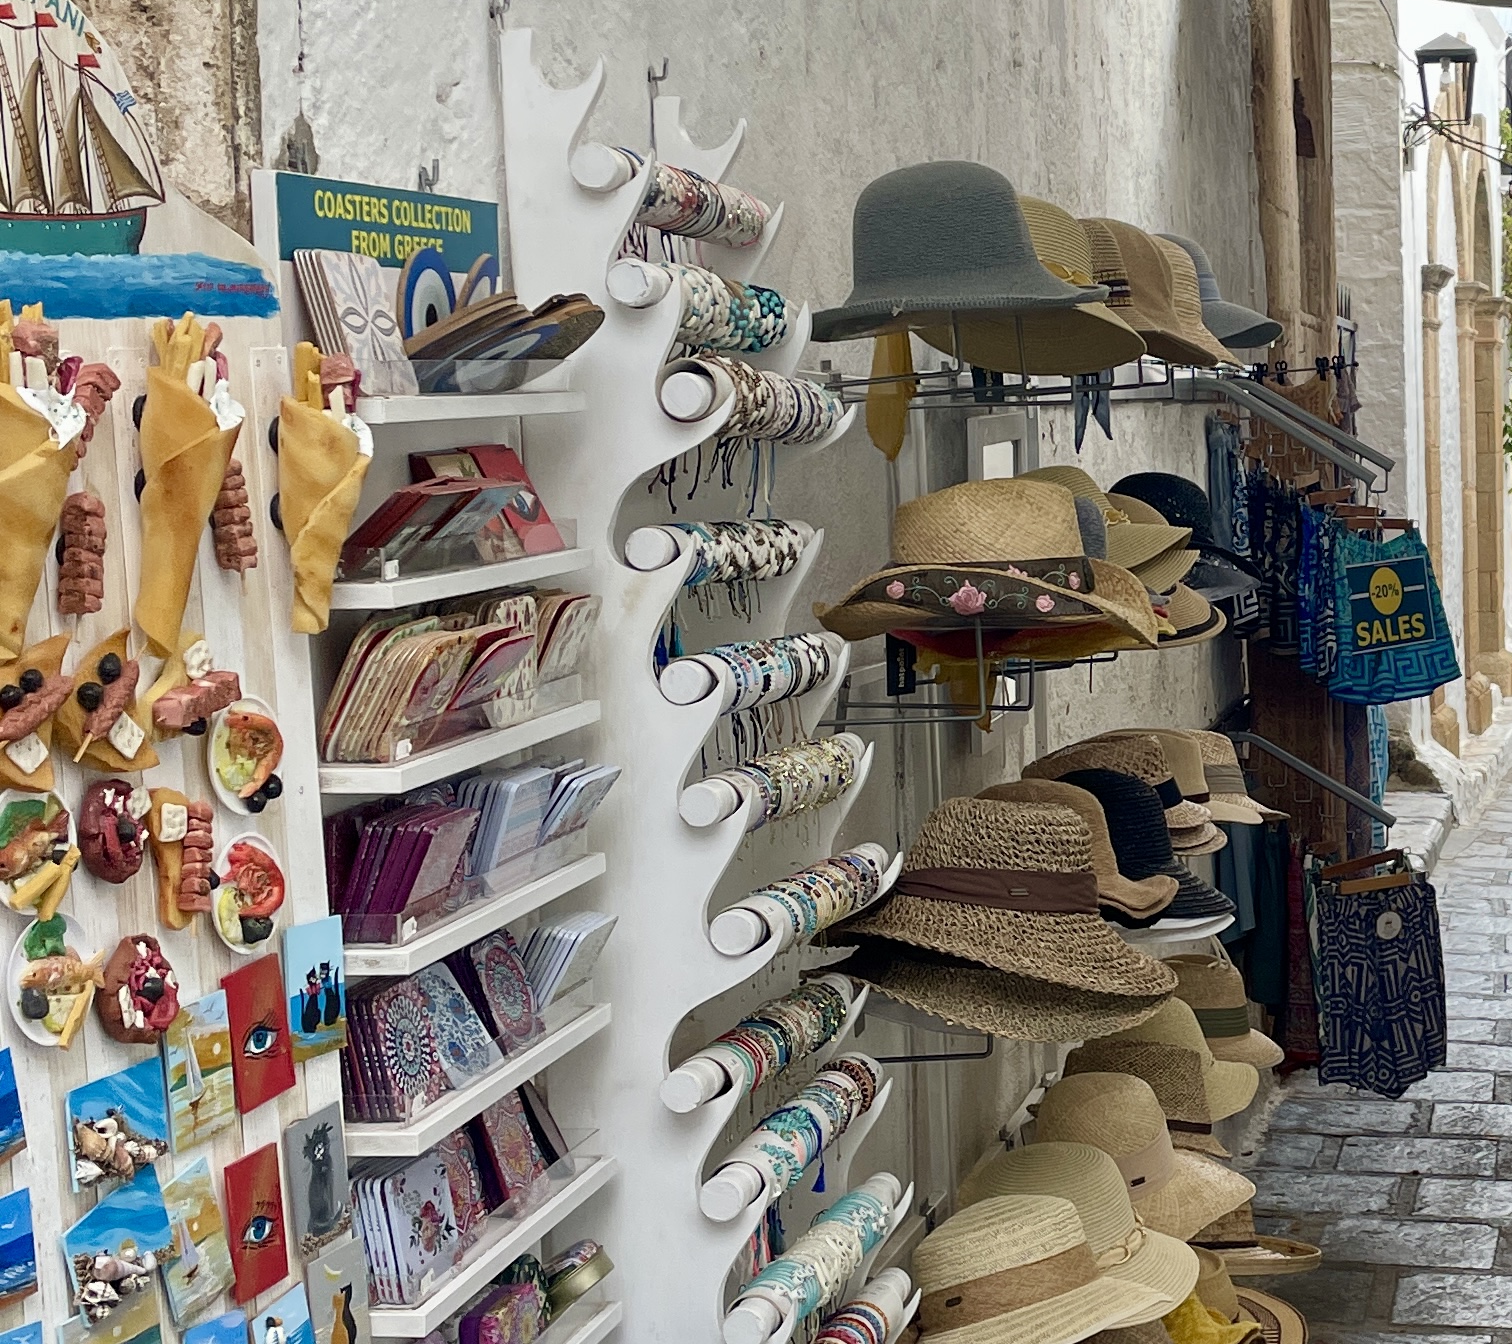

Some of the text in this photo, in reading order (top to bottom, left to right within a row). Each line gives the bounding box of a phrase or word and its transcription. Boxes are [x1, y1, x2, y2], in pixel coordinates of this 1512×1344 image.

[314, 189, 472, 234] COASTERS COLLECTION
[351, 229, 391, 259] FROM
[1372, 583, 1400, 599] -20%
[1356, 612, 1426, 647] SALES
